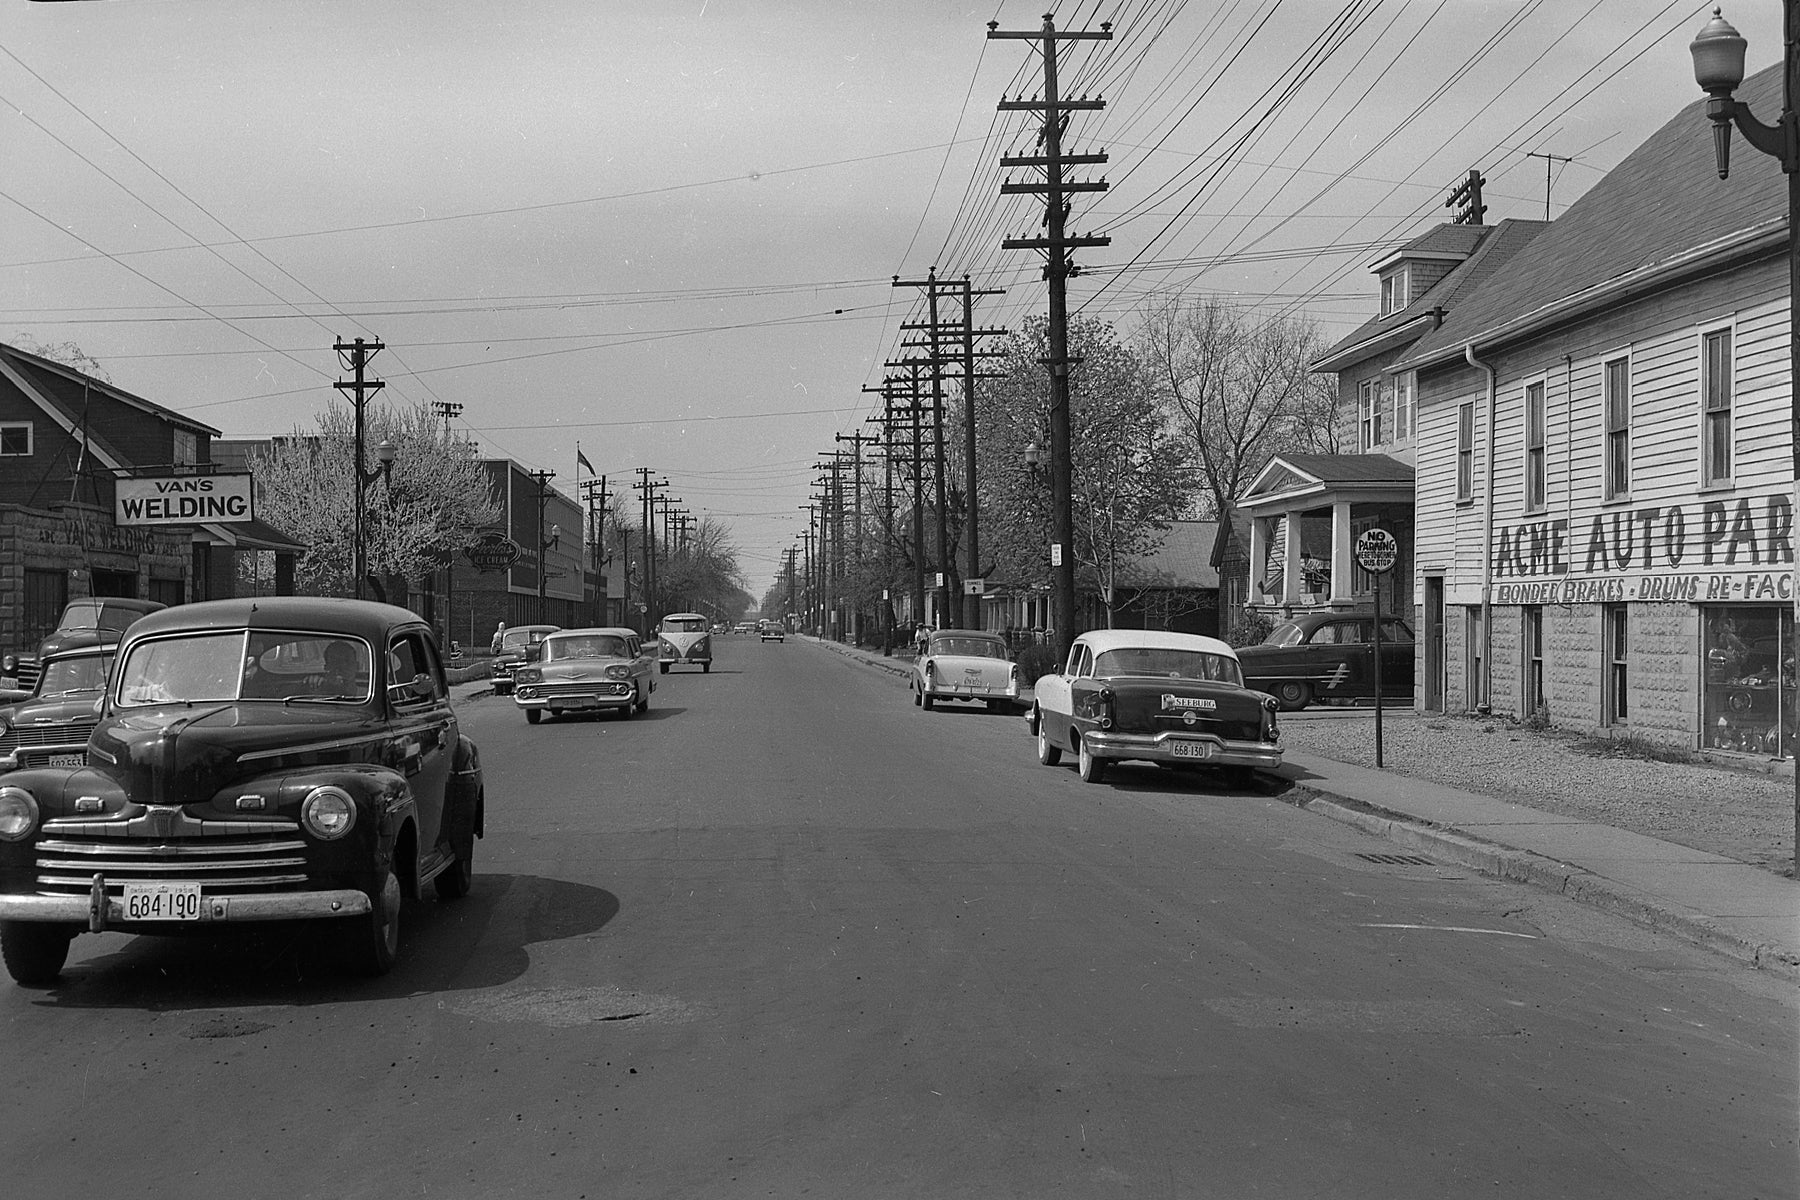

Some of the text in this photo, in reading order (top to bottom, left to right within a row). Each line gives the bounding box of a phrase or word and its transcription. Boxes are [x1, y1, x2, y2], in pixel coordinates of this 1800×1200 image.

[155, 479, 213, 493] VAN'S
[121, 495, 248, 520] WELDING
[1367, 531, 1386, 541] NO
[1496, 519, 1569, 578] ACME
[1585, 504, 1686, 574] AUTO
[1358, 540, 1396, 551] PARKING
[486, 555, 509, 564] CREAM
[1363, 559, 1392, 567] BUS STOP
[1499, 583, 1557, 603] BONDED
[1563, 578, 1625, 602] BRAKES
[1638, 576, 1700, 600] DRUMS
[1176, 698, 1215, 708] SEEBURG
